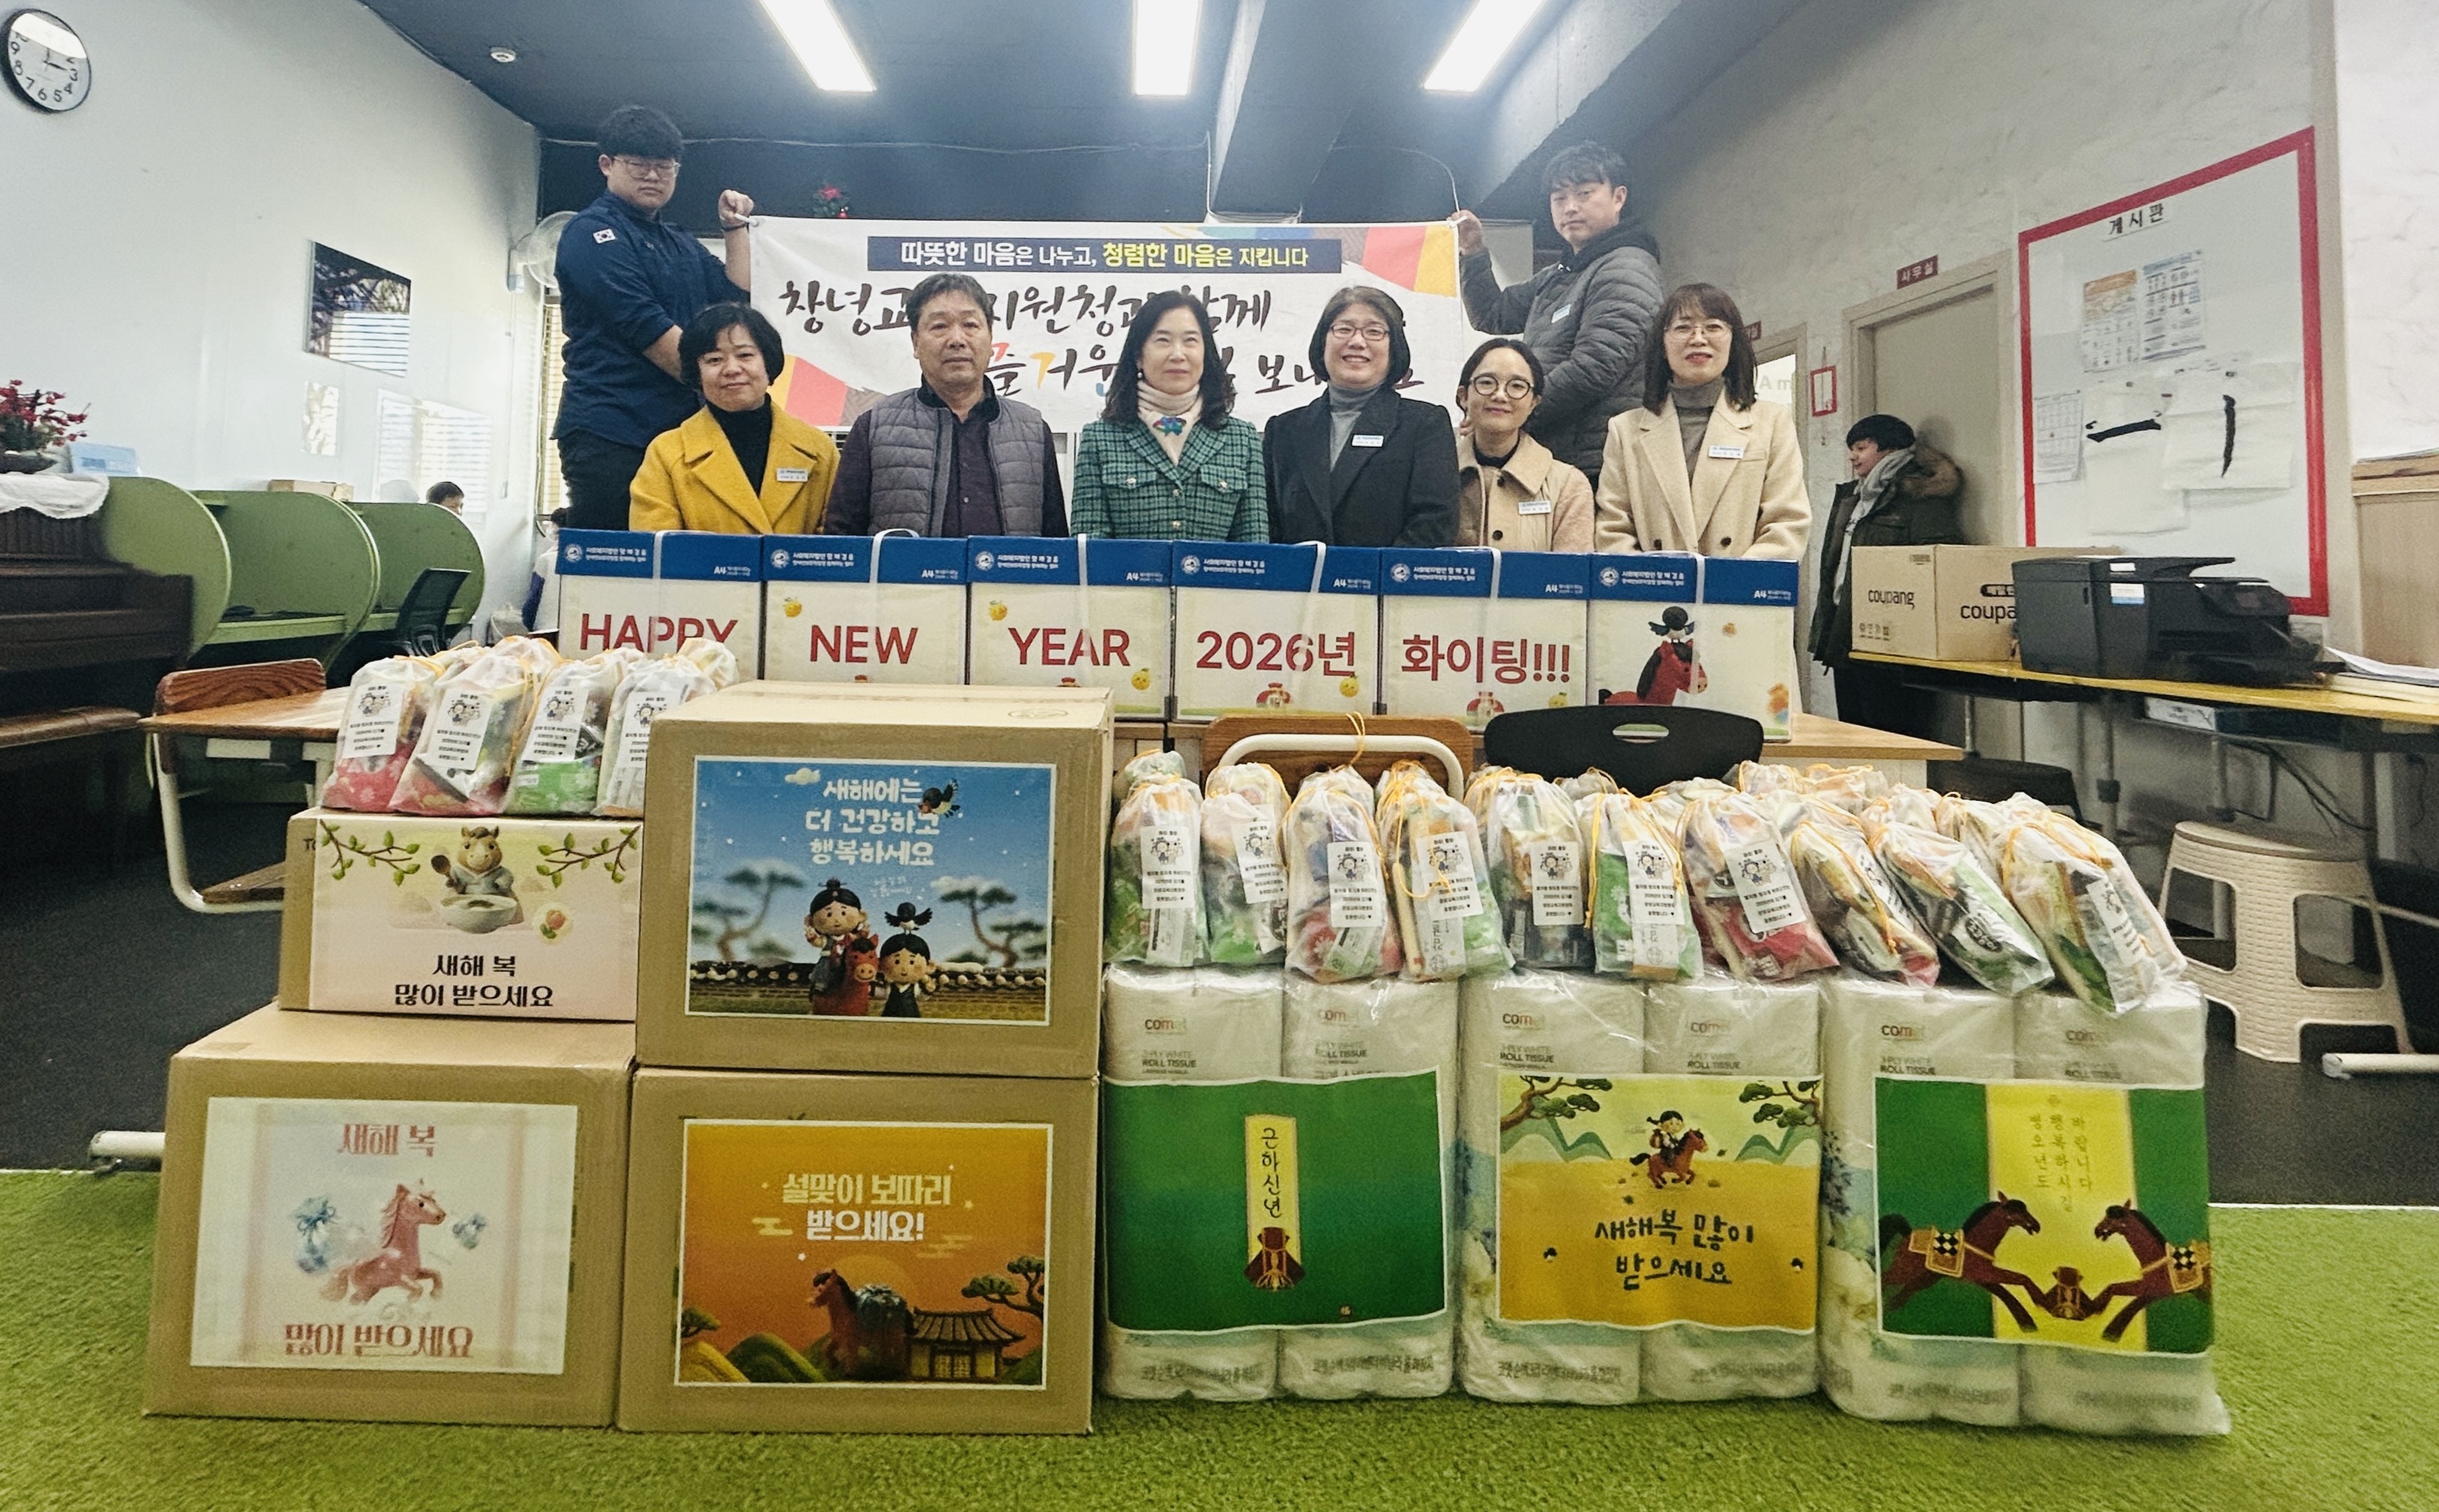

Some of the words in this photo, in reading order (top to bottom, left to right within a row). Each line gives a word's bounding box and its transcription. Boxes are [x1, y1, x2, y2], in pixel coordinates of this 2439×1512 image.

[901, 242, 967, 267] 따뜻한
[974, 243, 1033, 267] 마음은
[1039, 246, 1096, 267] 나누고,
[1102, 242, 1168, 268] 청렴한
[1174, 243, 1233, 268] 마음은
[1239, 247, 1309, 267] 지킵니다
[714, 566, 726, 574] A4
[1126, 572, 1139, 580] A4
[1333, 578, 1346, 588] A4
[1545, 584, 1558, 593] A4
[1754, 590, 1767, 598] A4
[810, 625, 918, 664] NEW
[1008, 628, 1130, 667] YEAR
[1196, 631, 1355, 676] 2026년
[1401, 634, 1569, 684] 화이팅!!!
[823, 778, 924, 804] 새해에는
[806, 810, 830, 833] 더
[840, 809, 940, 836] 건강하고
[810, 839, 935, 866] 행복하세요
[433, 955, 484, 977] 새해
[493, 956, 517, 977] 복
[394, 984, 444, 1007] 많이
[452, 985, 553, 1007] 받으세요
[1168, 1059, 1196, 1068] TISSUE
[339, 1123, 399, 1155] 새해
[409, 1125, 436, 1157] 복
[1262, 1128, 1282, 1218] 근하신년
[782, 1173, 863, 1204] 설맞이
[870, 1175, 951, 1206] 보따리
[806, 1209, 924, 1242] 받으세요!
[1693, 1214, 1754, 1251] 많이
[1615, 1253, 1732, 1291] 받으세요
[285, 1324, 343, 1357] 많이
[354, 1324, 473, 1358] 받으세요
